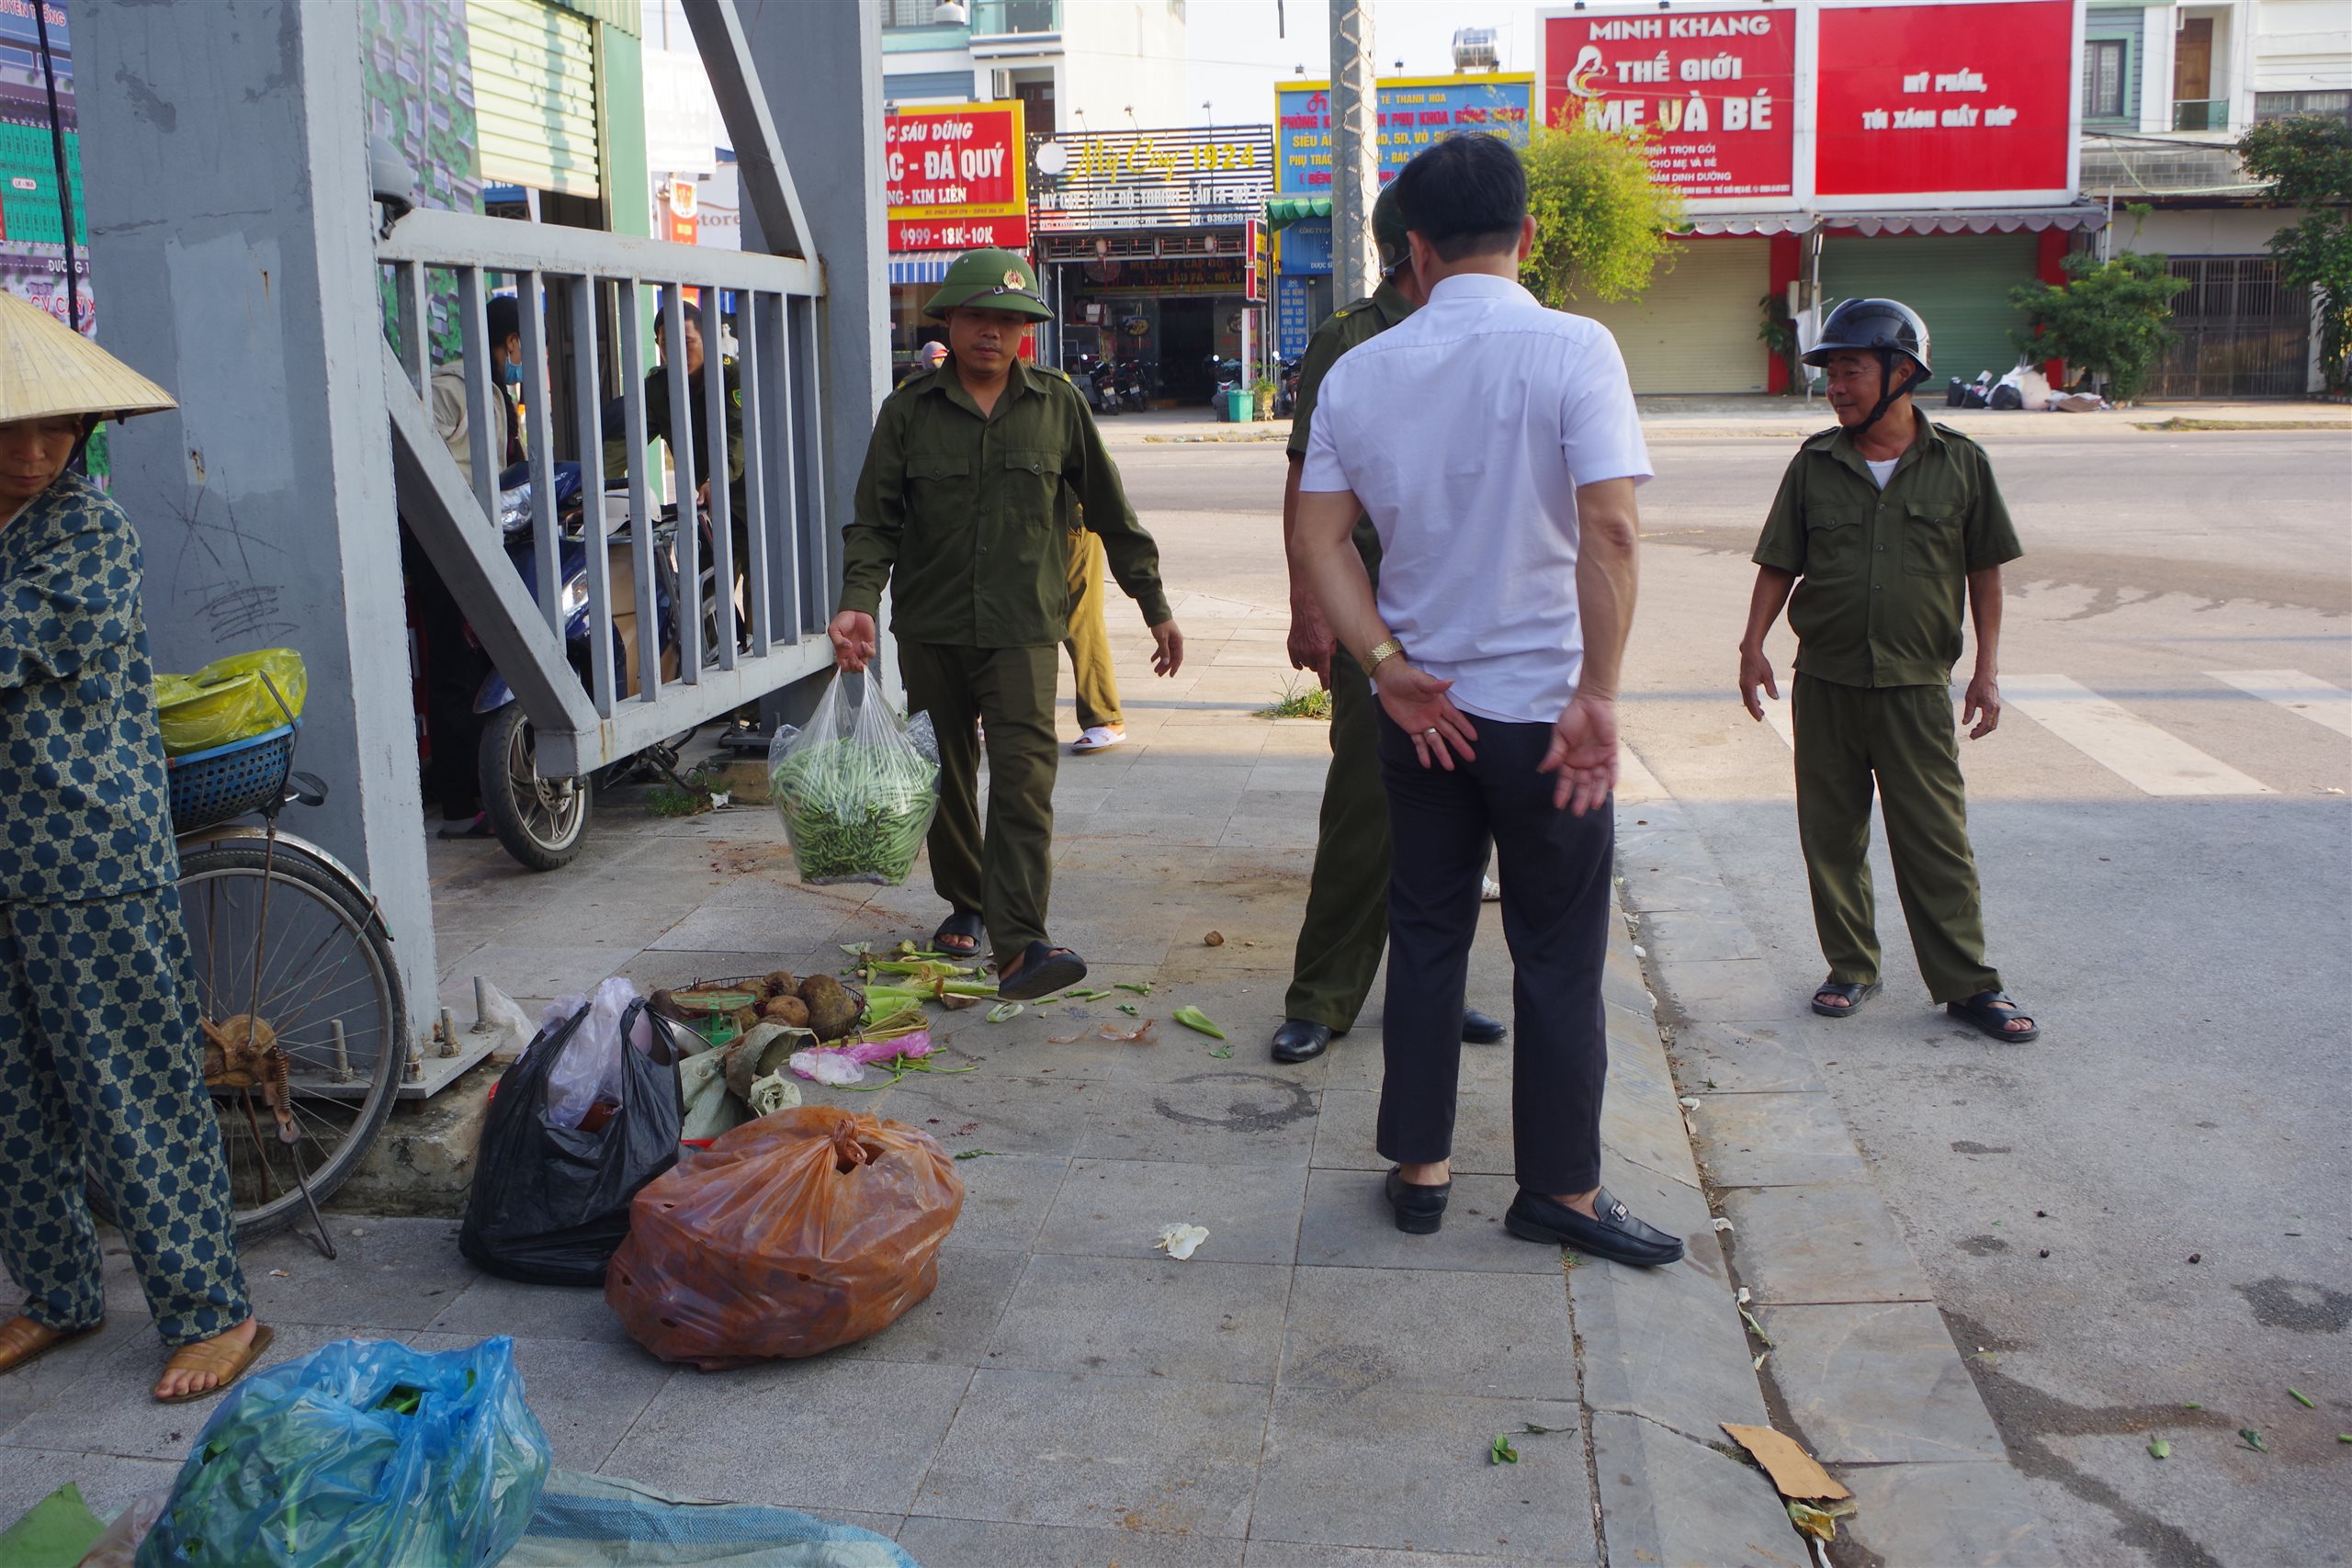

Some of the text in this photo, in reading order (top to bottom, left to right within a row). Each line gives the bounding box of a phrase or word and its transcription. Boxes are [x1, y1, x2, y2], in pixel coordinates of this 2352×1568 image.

[29, 3, 66, 27] TỐNG
[1589, 16, 1771, 41] MINH KHANG
[1616, 50, 1743, 83] THẾ GIỚI
[1396, 95, 1424, 104] THANH
[1280, 112, 1317, 129] PHÒNG
[1392, 112, 1415, 129] PHỤ
[1419, 111, 1449, 126] KHOA
[1585, 88, 1772, 141] MẸ VÀ BÉ
[899, 121, 927, 142] SÁU
[1293, 132, 1317, 147] SIÊU
[1414, 130, 1429, 144] VÔ
[1190, 143, 1256, 171] 1924
[1669, 145, 1696, 156] TRỌN
[1698, 142, 1715, 154] GÓI
[924, 144, 956, 180] ĐÁ
[960, 141, 1005, 182] QUÝ
[1289, 155, 1307, 168] PHỤ
[1650, 159, 1671, 168] CHO
[1673, 159, 1688, 170] MẸ
[1704, 157, 1717, 167] BÉ
[1672, 173, 1695, 182] DINH
[911, 188, 935, 205] KIM
[938, 184, 967, 204] LIÊN
[900, 228, 931, 246] 9999
[48, 257, 83, 274] ĐƯỜG
